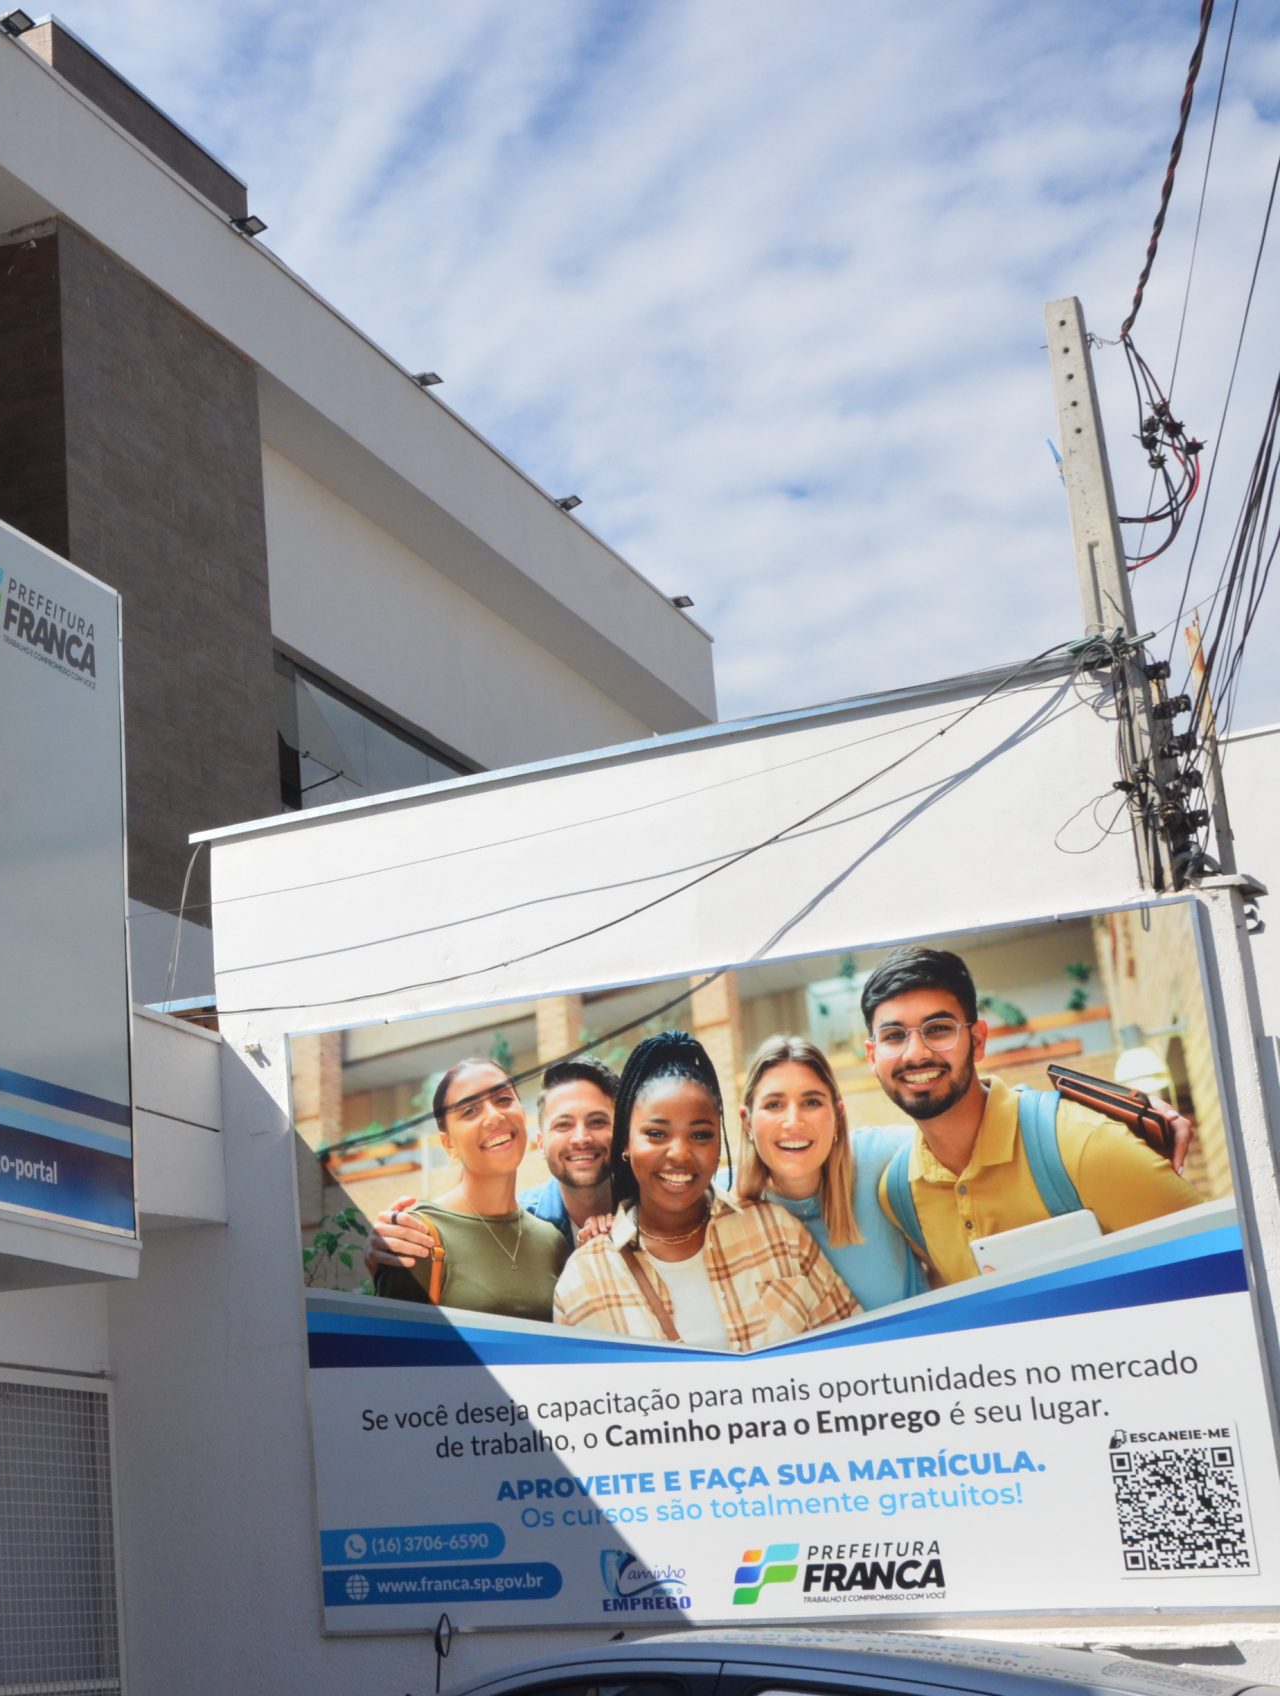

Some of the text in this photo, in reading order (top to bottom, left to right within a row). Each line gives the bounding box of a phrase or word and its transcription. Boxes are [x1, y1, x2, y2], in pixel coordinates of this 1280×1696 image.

[8, 578, 94, 640] PREFEITURA
[3, 598, 96, 678] FRANCA
[362, 1350, 1198, 1431] Se você deseja capacitação para mais oportunidades no mercado
[436, 1396, 1110, 1458] de trabalho, o Caminho para o Emprego é seu lugar.
[1129, 1427, 1230, 1444] ESCANEIE-ME
[496, 1449, 1047, 1500] APROVEITE E FAÇA SUA MATRÍCULA.
[520, 1481, 1024, 1528] Os cursos são totalmente gratuitos!
[372, 1533, 488, 1556] (16) 3706-6590
[807, 1540, 940, 1560] PREFEITURA
[377, 1573, 544, 1594] www.franca.sp.gov.br
[803, 1558, 946, 1592] FRANCA
[602, 1596, 692, 1612] EMPREGO
[848, 1594, 905, 1602] COMPROMISSO
[906, 1592, 924, 1600] COM
